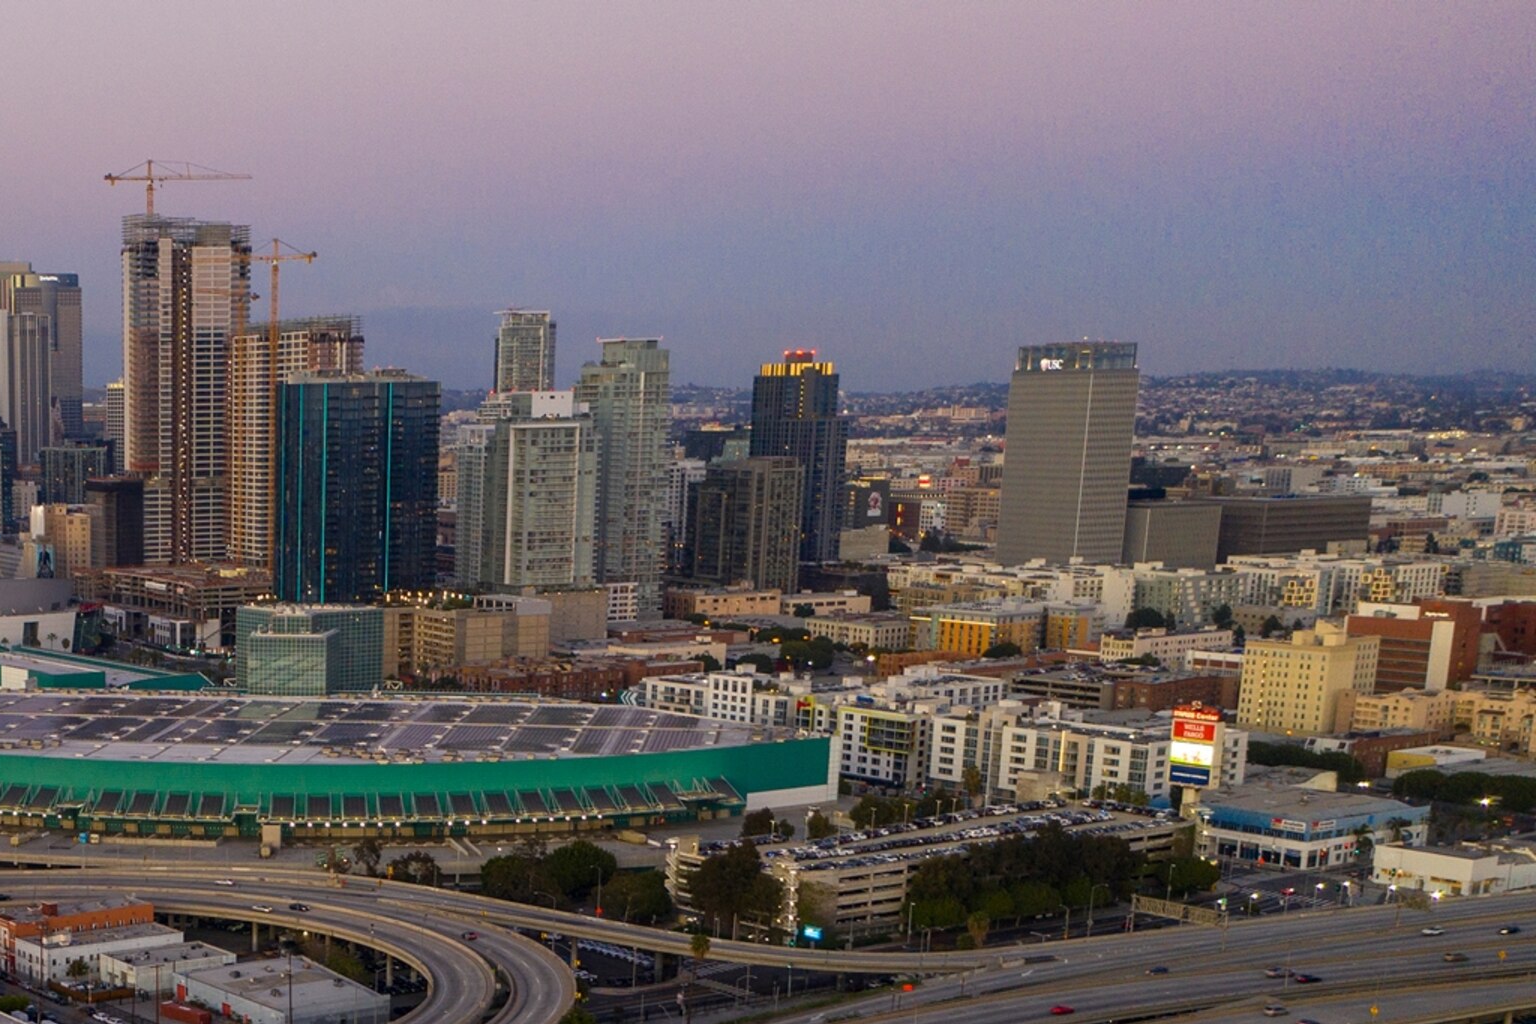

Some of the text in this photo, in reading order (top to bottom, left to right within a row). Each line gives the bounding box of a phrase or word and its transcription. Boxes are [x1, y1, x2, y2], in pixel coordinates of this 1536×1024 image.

[1047, 359, 1064, 370] USC
[1184, 724, 1205, 732] WELLS
[1183, 730, 1205, 739] FARGO
